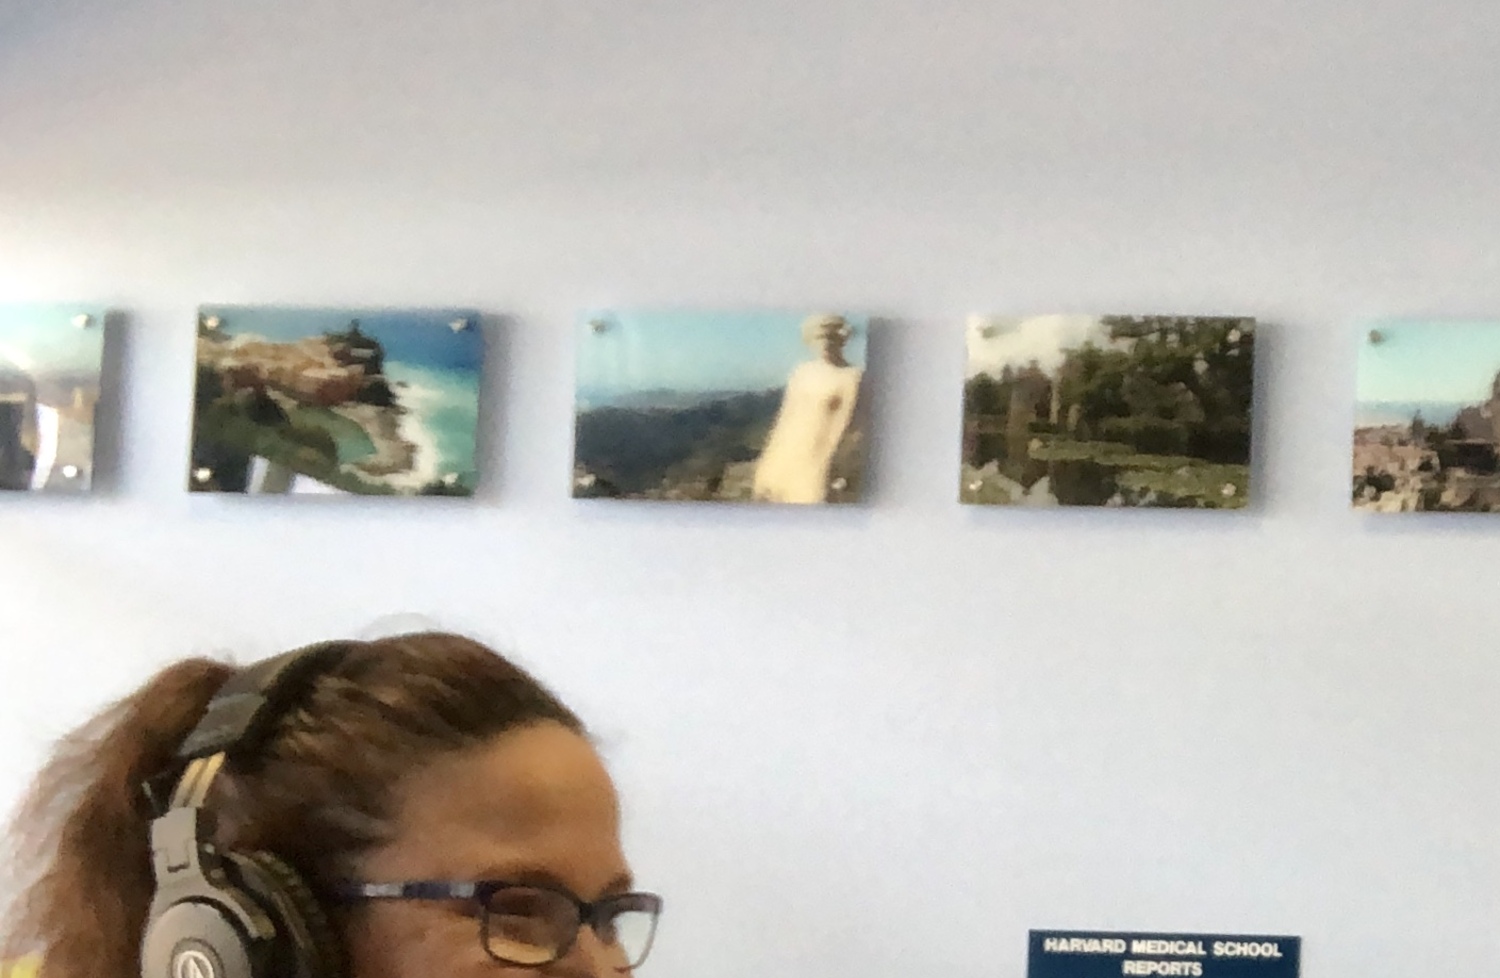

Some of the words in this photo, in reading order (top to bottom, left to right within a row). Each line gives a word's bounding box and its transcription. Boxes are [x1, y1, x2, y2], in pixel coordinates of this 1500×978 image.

[1044, 938, 1127, 954] HARVARD
[1131, 940, 1207, 956] MEDICAL
[1213, 941, 1283, 957] SCHOOL
[1122, 960, 1203, 976] REPORTS
